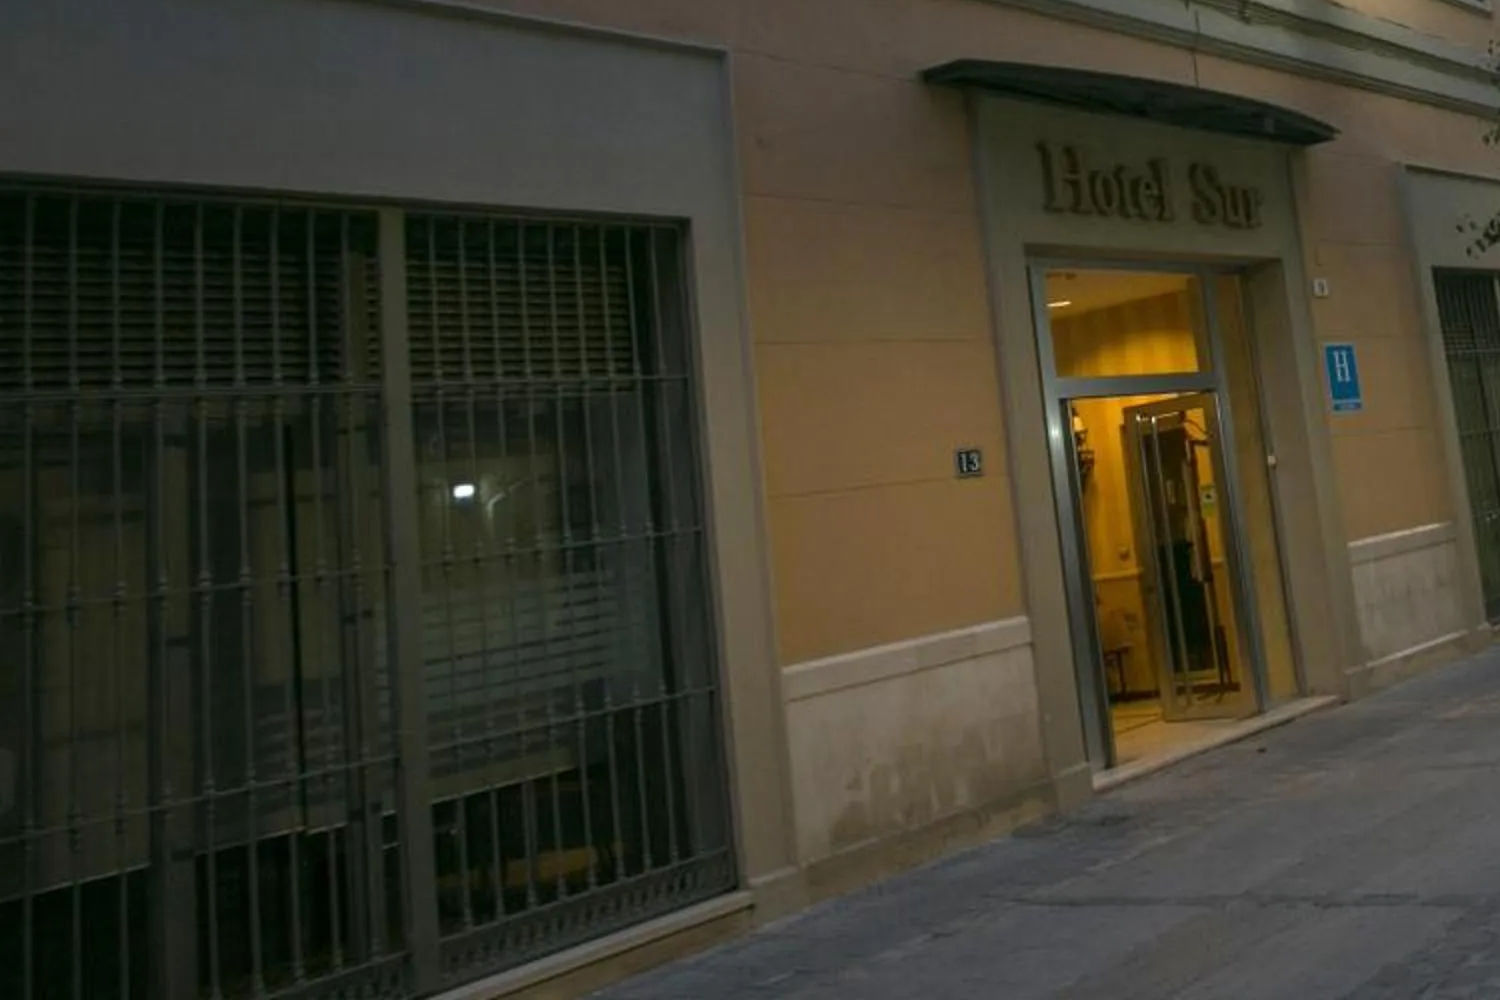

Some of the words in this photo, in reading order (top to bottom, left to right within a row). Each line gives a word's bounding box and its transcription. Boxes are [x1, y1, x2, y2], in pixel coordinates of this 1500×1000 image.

[1035, 140, 1176, 223] Hotel
[1188, 161, 1265, 230] Sur
[1332, 350, 1352, 383] H
[959, 451, 980, 473] 13
